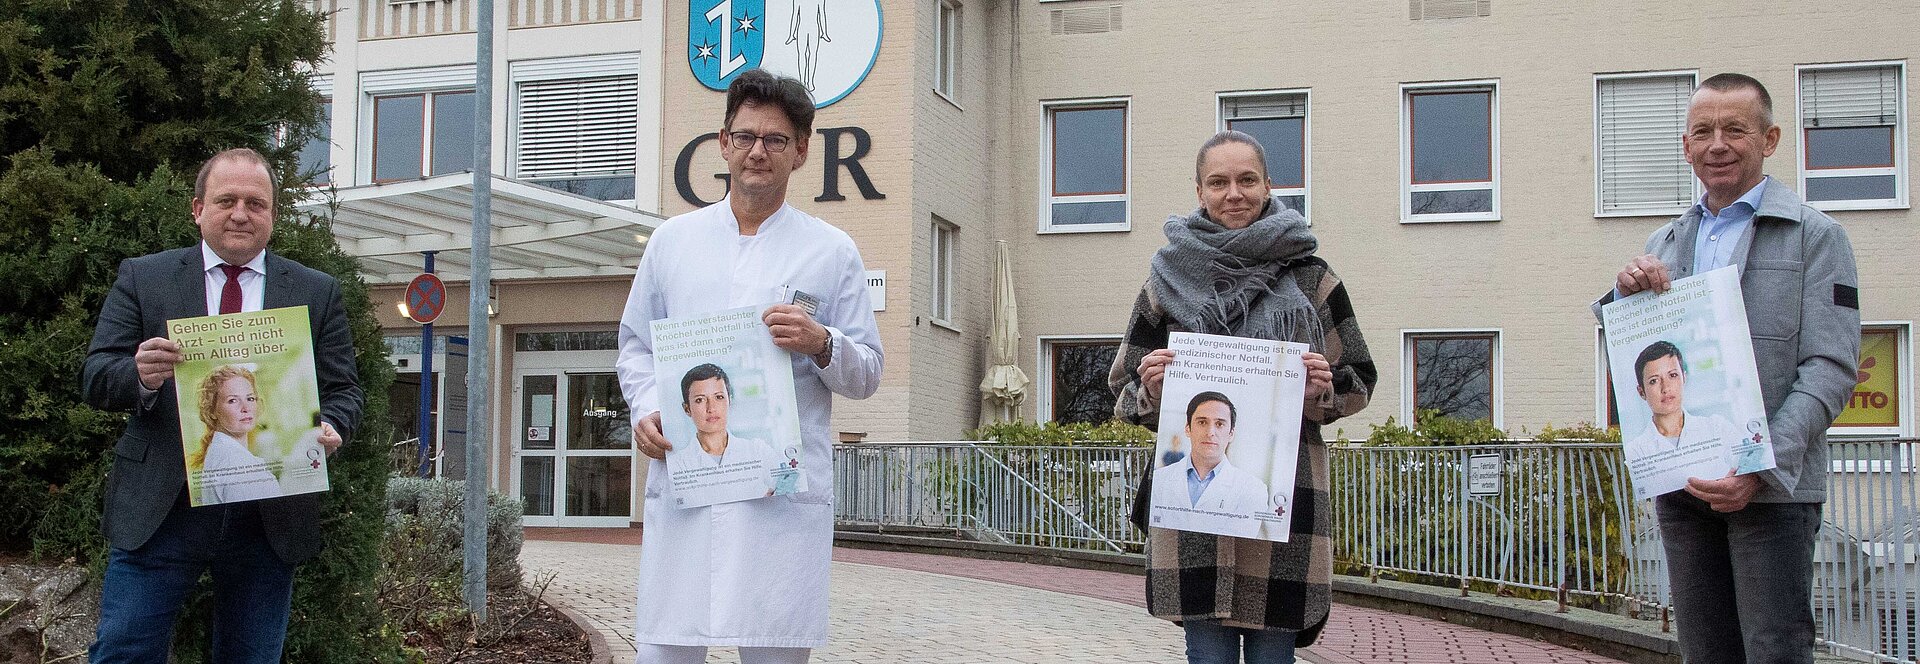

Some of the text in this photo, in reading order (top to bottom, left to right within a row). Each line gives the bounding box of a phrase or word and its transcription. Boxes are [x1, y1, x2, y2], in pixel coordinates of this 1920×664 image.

[674, 126, 886, 208] GR
[1606, 302, 1630, 315] Wenn
[1632, 295, 1645, 306] ein
[1608, 308, 1642, 327] Knöchel
[1645, 303, 1658, 313] ein
[1660, 294, 1691, 308] Notfall
[1694, 289, 1706, 299] ist
[173, 315, 276, 335] Gehen Sie zum
[654, 322, 679, 331] Wenn
[699, 311, 755, 325] verstauchter
[1609, 308, 1685, 337] was ist dann eine
[220, 332, 245, 344] und
[250, 328, 284, 340] nicht
[655, 330, 692, 341] Knöchel
[695, 328, 709, 336] ein
[711, 323, 740, 334] Notfall
[744, 321, 755, 329] ist
[1611, 318, 1683, 348] Vergewaltigung?
[183, 343, 287, 361] um Alltag über.
[657, 345, 674, 353] was
[677, 341, 691, 349] ist
[691, 338, 714, 347] dann
[657, 345, 732, 362] Vergewaltigung?
[1173, 337, 1301, 355] Jede Vergewaltigung ist ein
[1239, 354, 1272, 364] Notfall.
[1169, 370, 1248, 386] Hilfe. Vertraulich.
[1184, 360, 1243, 373] Krankenhaus
[1245, 367, 1282, 377] erhalten
[1284, 370, 1299, 378] Sie
[583, 409, 617, 418] Ausgang
